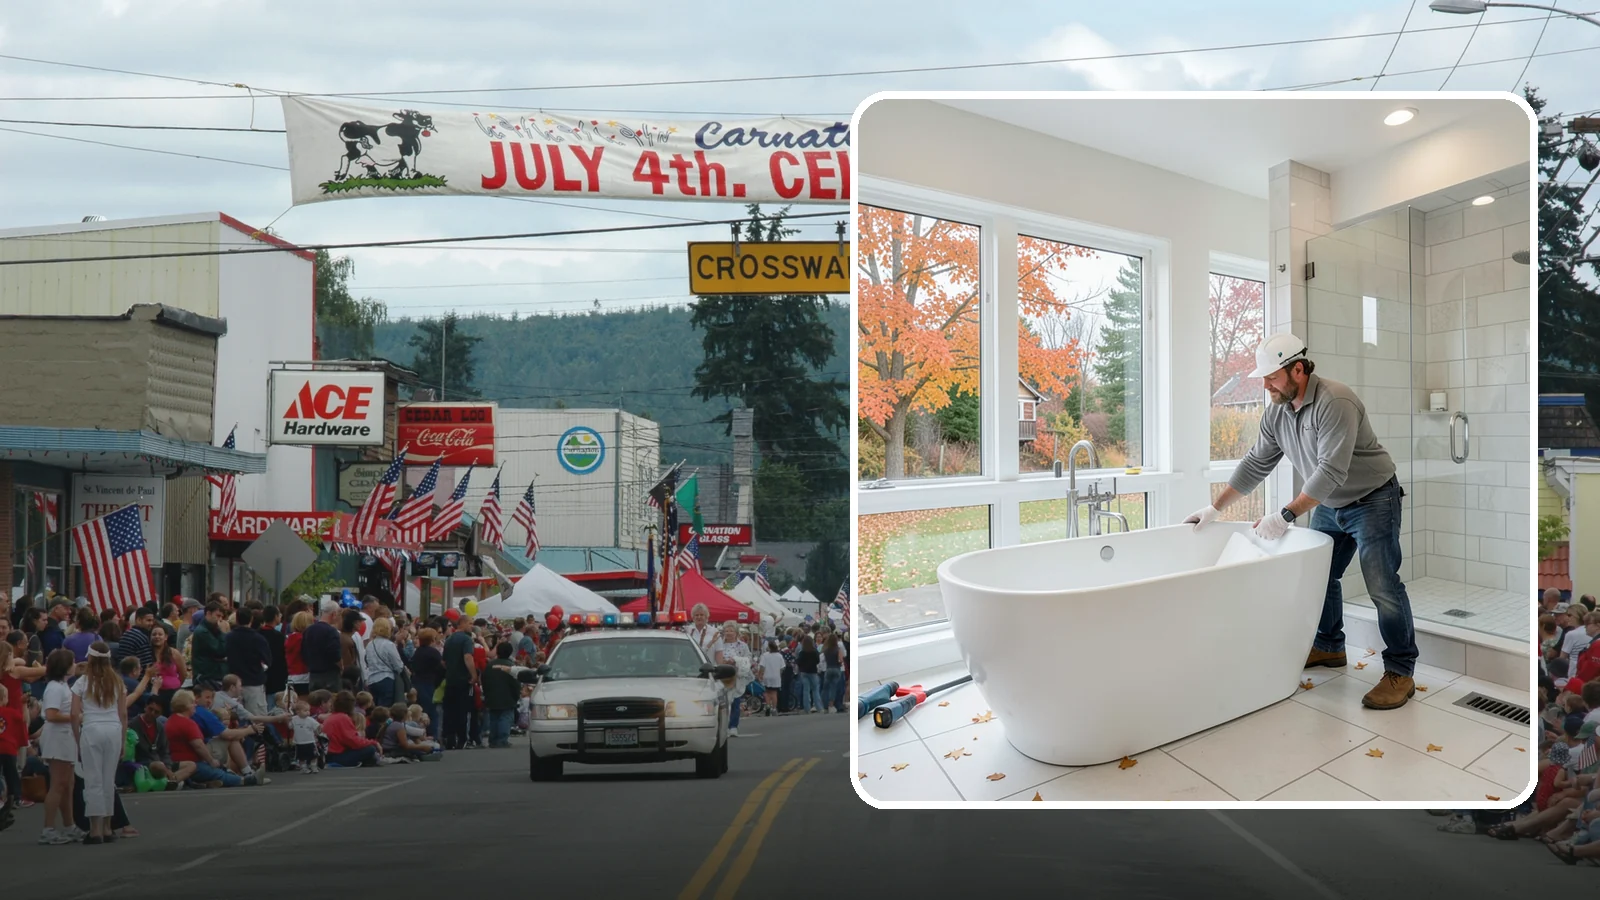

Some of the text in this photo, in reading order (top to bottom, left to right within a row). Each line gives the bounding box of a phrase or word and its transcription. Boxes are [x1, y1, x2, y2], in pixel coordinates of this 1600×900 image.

[481, 141, 605, 193] JULY
[632, 150, 747, 198] 4th.
[697, 254, 850, 280] CROSSWA
[283, 380, 373, 420] ACE
[406, 409, 452, 422] CEDAR
[283, 421, 370, 437] Hardware
[354, 467, 385, 479] Simpl
[96, 485, 124, 495] Vincent
[126, 486, 136, 495] de
[138, 486, 155, 495] Paul
[81, 503, 153, 522] THT
[213, 516, 330, 535] HARDARE
[688, 526, 741, 535] CRNATION
[699, 535, 730, 543] GLASS
